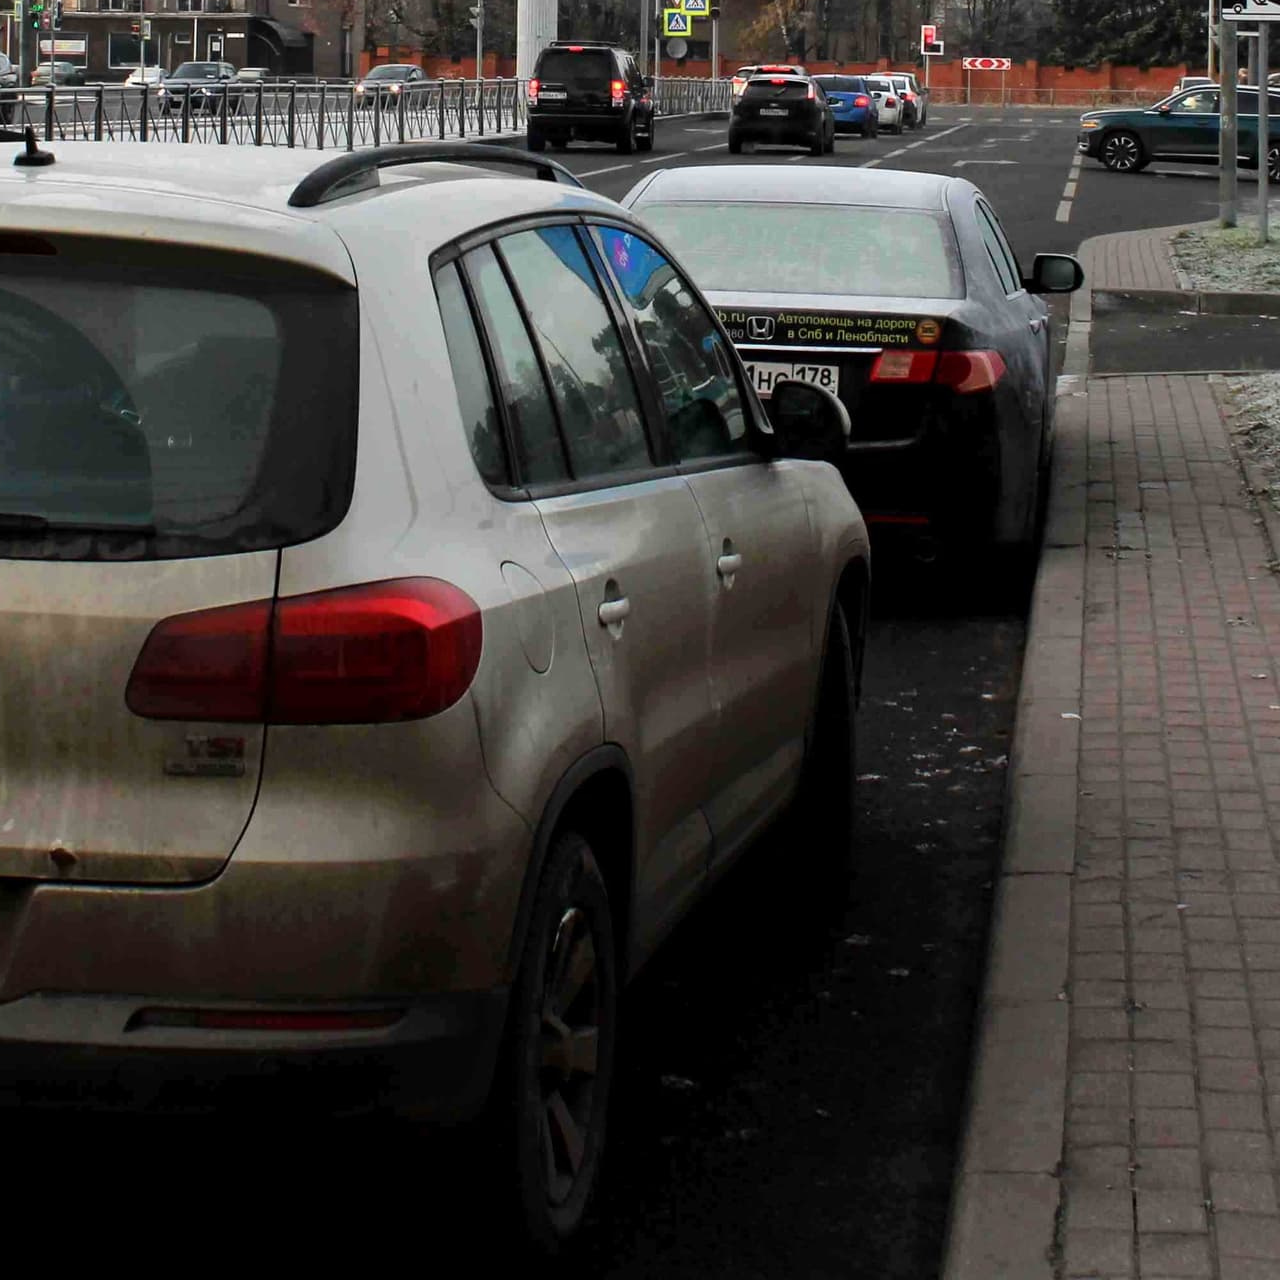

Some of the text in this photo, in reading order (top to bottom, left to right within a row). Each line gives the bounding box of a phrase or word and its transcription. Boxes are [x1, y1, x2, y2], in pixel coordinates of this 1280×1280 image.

[776, 313, 854, 328] Автопомощь
[857, 317, 872, 326] на
[875, 320, 916, 330] дороге
[787, 328, 909, 343] в Спб и Ленобласти
